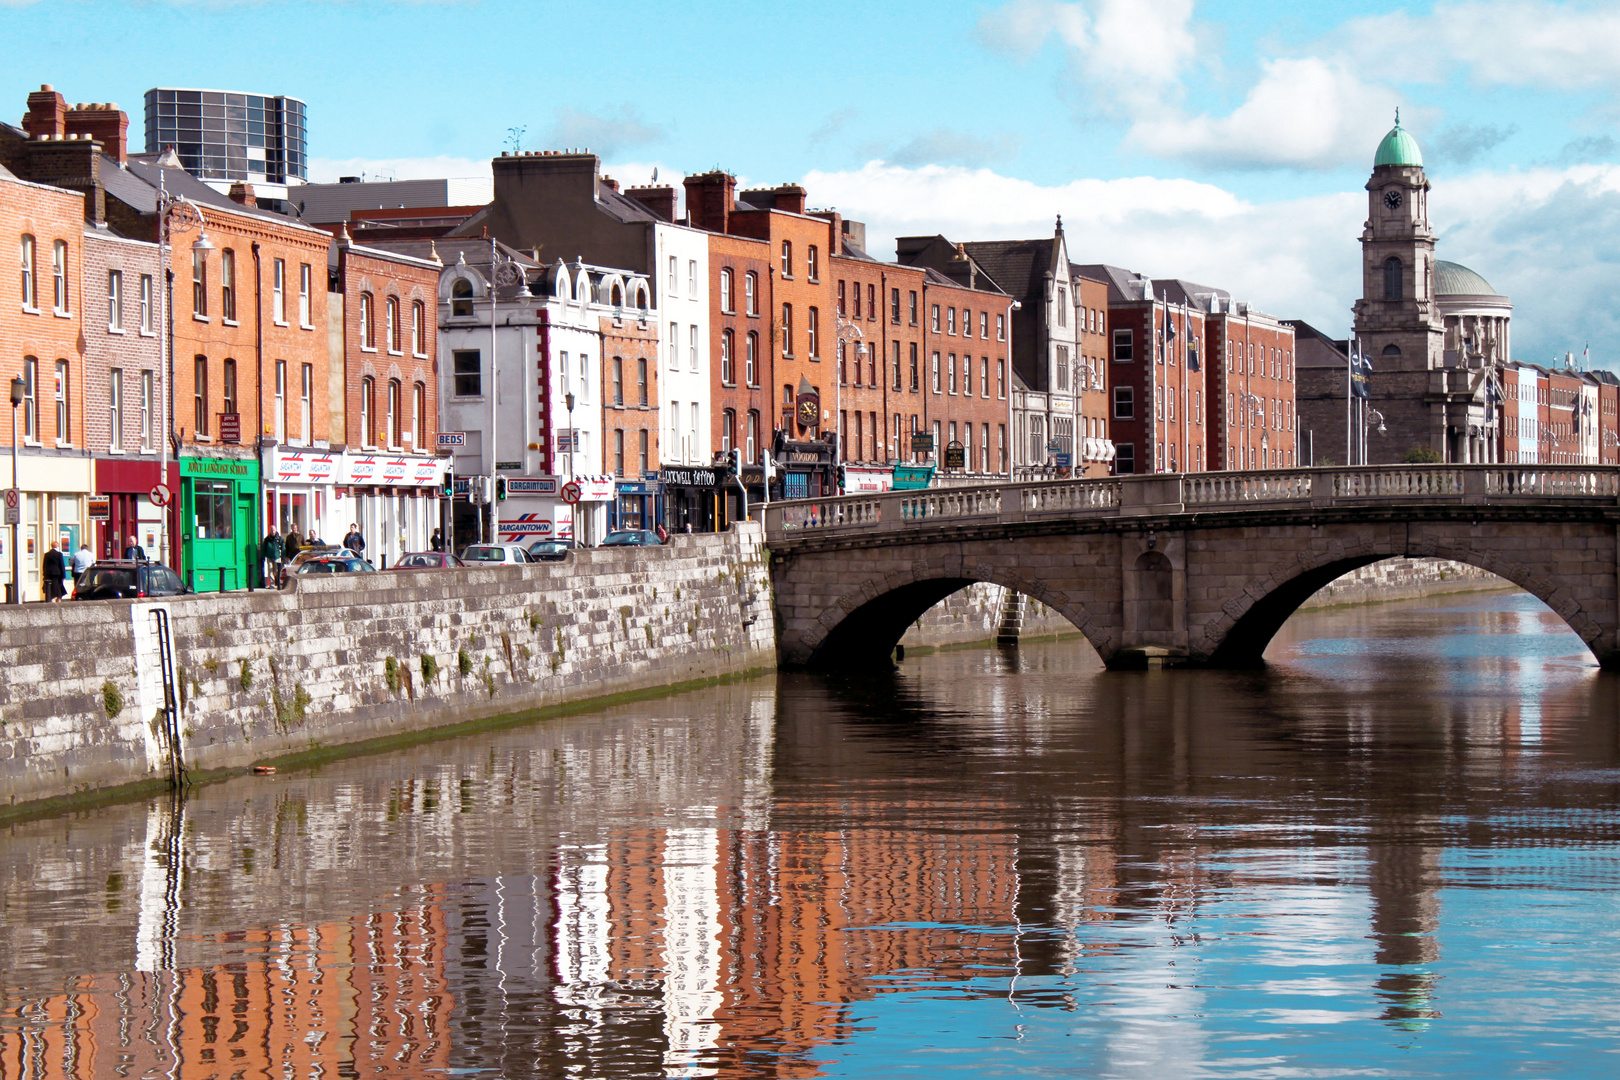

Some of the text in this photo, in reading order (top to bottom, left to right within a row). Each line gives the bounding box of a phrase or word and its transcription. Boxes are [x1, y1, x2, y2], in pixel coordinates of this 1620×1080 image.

[439, 435, 462, 444] BEDS
[792, 452, 818, 462] VOODOO
[510, 481, 553, 490] BARGAINTOWN
